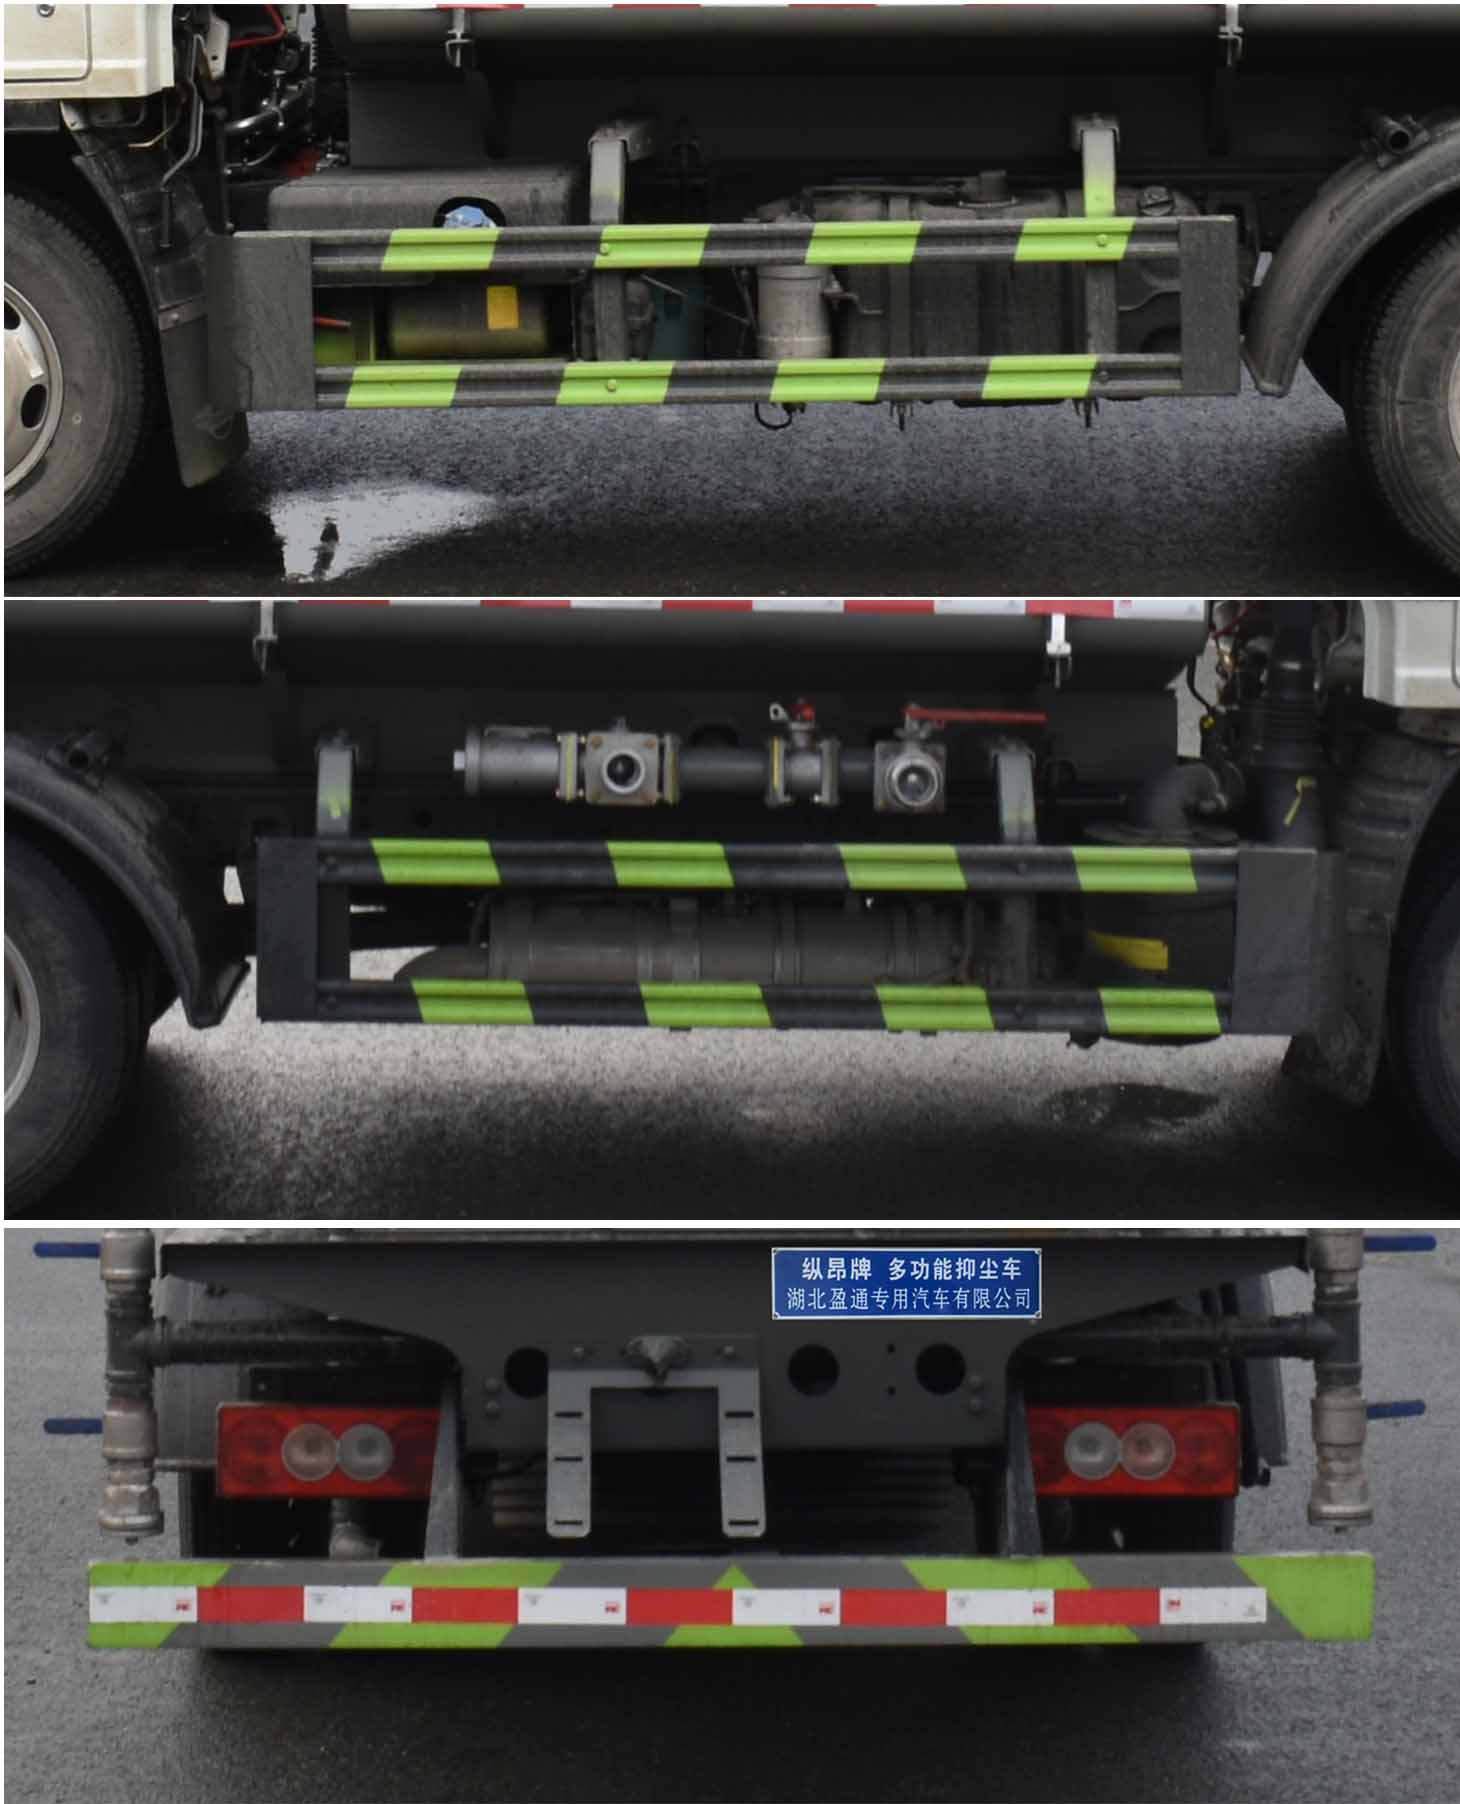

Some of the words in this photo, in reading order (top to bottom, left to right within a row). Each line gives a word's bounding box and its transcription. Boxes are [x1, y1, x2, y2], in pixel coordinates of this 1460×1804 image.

[802, 1257, 872, 1280] 纵昂牌
[888, 1257, 1021, 1280] 多功能抑尘车
[787, 1287, 1031, 1310] 湖北盈通专用汽车有限公司
